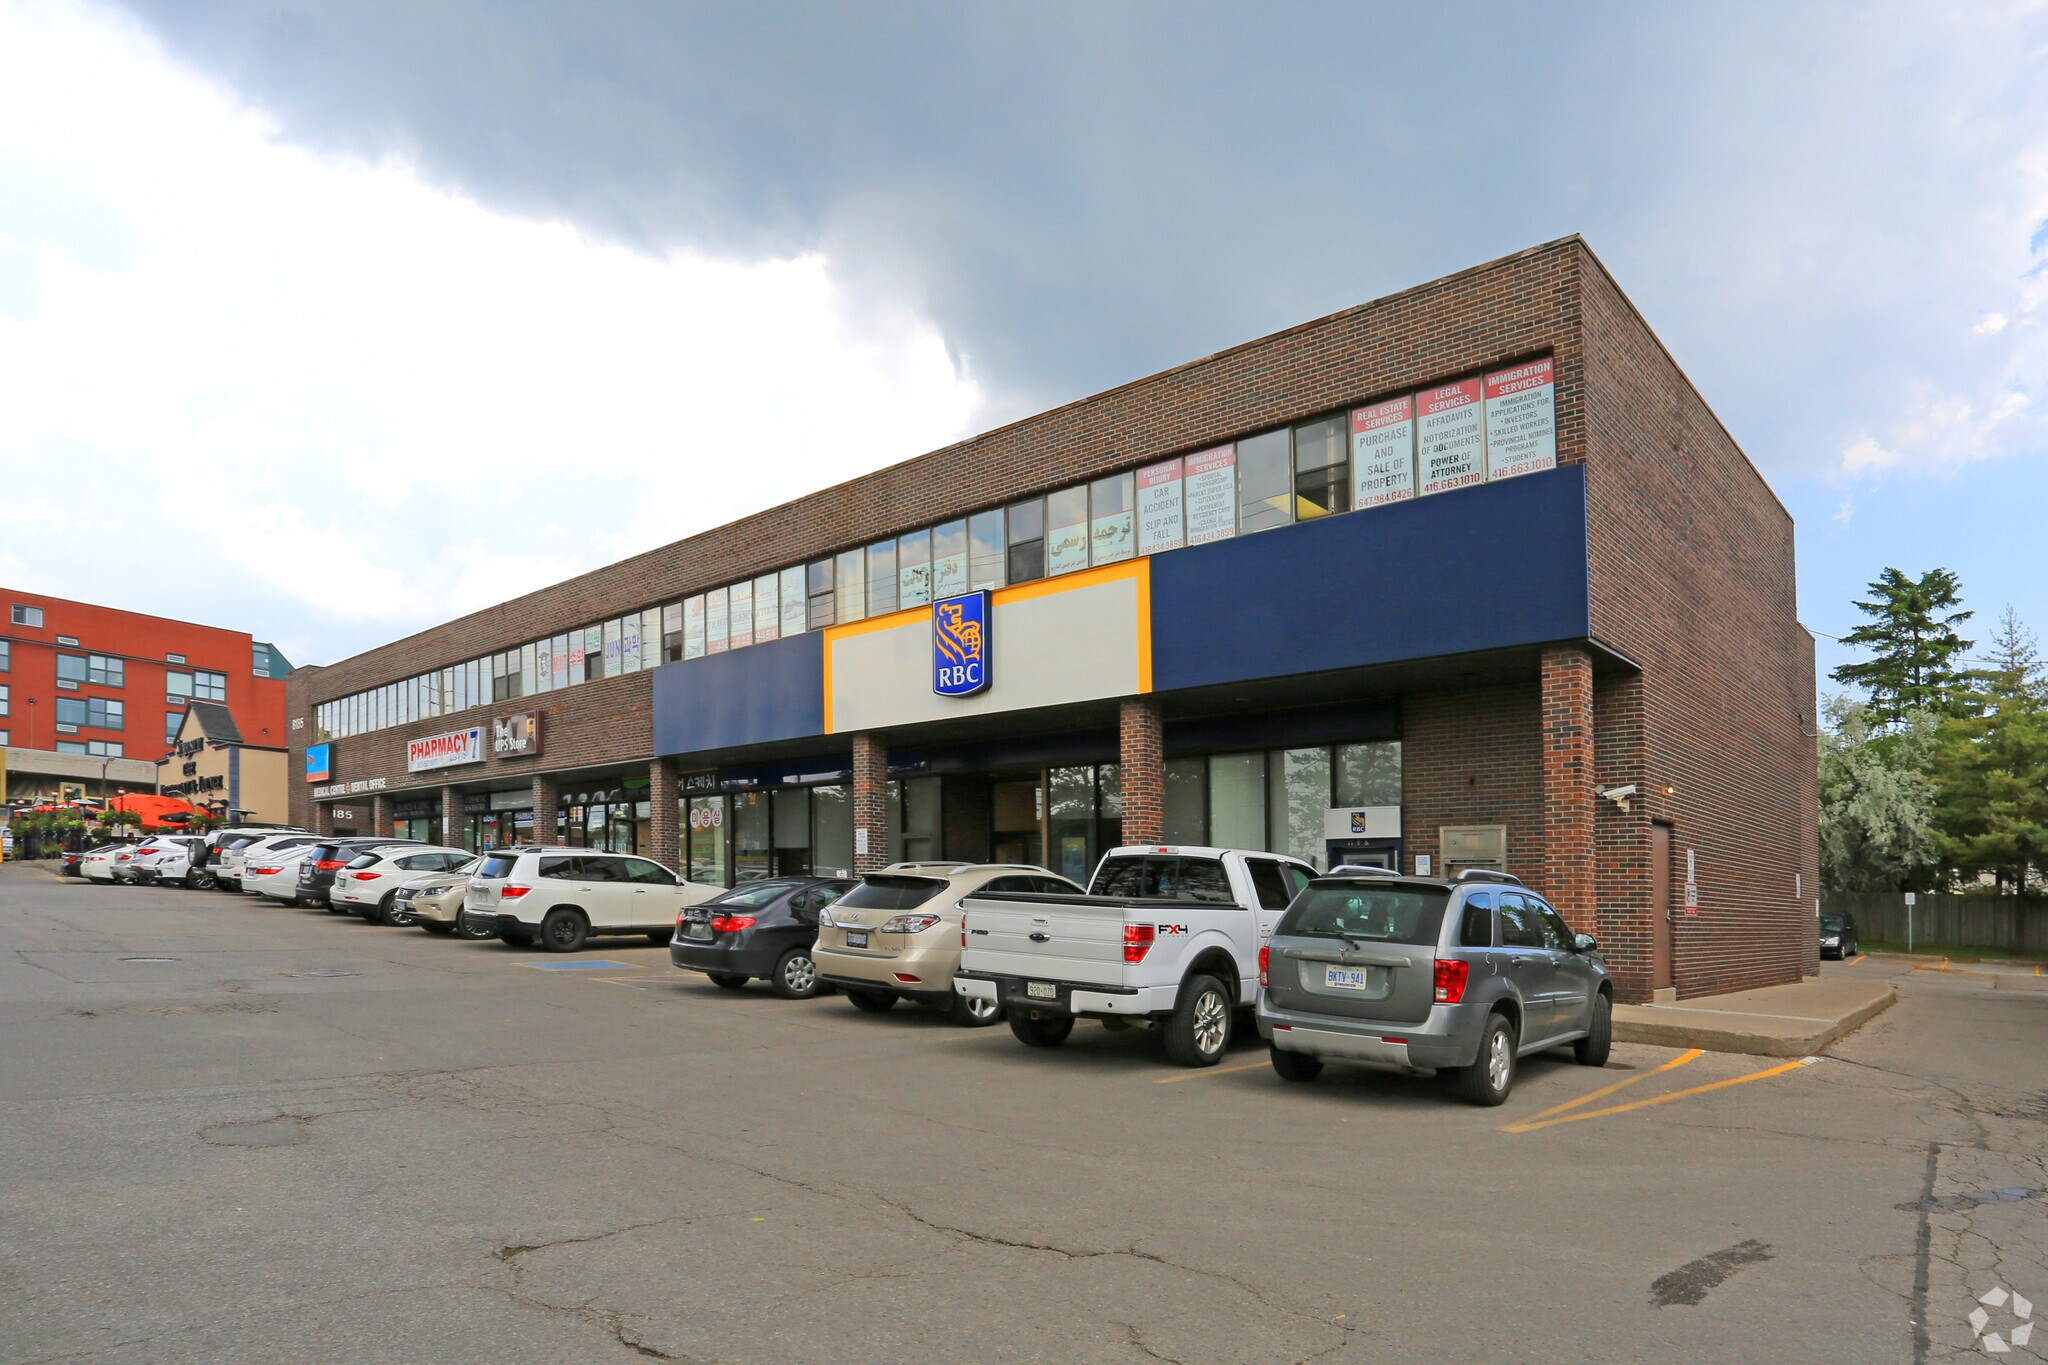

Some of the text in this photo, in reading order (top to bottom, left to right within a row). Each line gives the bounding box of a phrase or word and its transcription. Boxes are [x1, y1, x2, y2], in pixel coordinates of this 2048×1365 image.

[1488, 362, 1550, 387] IMMIGRATION
[1435, 385, 1462, 400] LEGAL
[1499, 375, 1544, 395] SERVICES
[1428, 394, 1471, 413] SERVICES
[1499, 391, 1542, 407] IMMIGRATION
[1357, 401, 1408, 422] REAL ESTATE
[1426, 409, 1473, 428] AFFADAVITS
[1490, 402, 1535, 418] APPLICATIONS
[1505, 411, 1537, 424] INVESTORS
[1365, 412, 1403, 429] SERVICES
[1494, 417, 1549, 437] SKILLED WORKERS
[1359, 427, 1408, 448] PURCHASE
[1423, 424, 1478, 444] NOTORIZATION
[1493, 428, 1553, 448] PROVINCIAL NOMINEE
[1374, 446, 1393, 460] AND
[1422, 435, 1480, 455] OF DOCUMENTS
[1505, 440, 1539, 454] PROGRAMS
[1188, 448, 1233, 466] IMMIGRATION
[1430, 451, 1471, 468] POWER OF
[1505, 451, 1537, 464] STUDENTS
[1143, 463, 1176, 478] PERSONAL
[1195, 459, 1228, 474] SERVICES
[1367, 457, 1405, 476] SALE OF
[1431, 463, 1472, 479] ATTORNEY
[1492, 457, 1552, 478] 416.663.1010
[1149, 474, 1171, 486] INJURY
[1361, 472, 1408, 492] PROPERTY
[1424, 473, 1480, 492] 416.663.1010
[1154, 486, 1169, 499] CAR
[1358, 488, 1412, 508] 647.984.6426
[1144, 497, 1179, 515] ACCIDENT
[1145, 515, 1179, 531] SLIP AND
[1153, 529, 1170, 541] FALL
[938, 662, 979, 688] RBC
[495, 725, 508, 738] The
[410, 733, 468, 761] PHARMACY
[470, 731, 478, 759] 7
[495, 738, 527, 752] UPS Store
[332, 809, 353, 820] 185
[691, 809, 722, 827] 미용실
[1352, 825, 1365, 833] RBC
[1158, 924, 1188, 935] FX4
